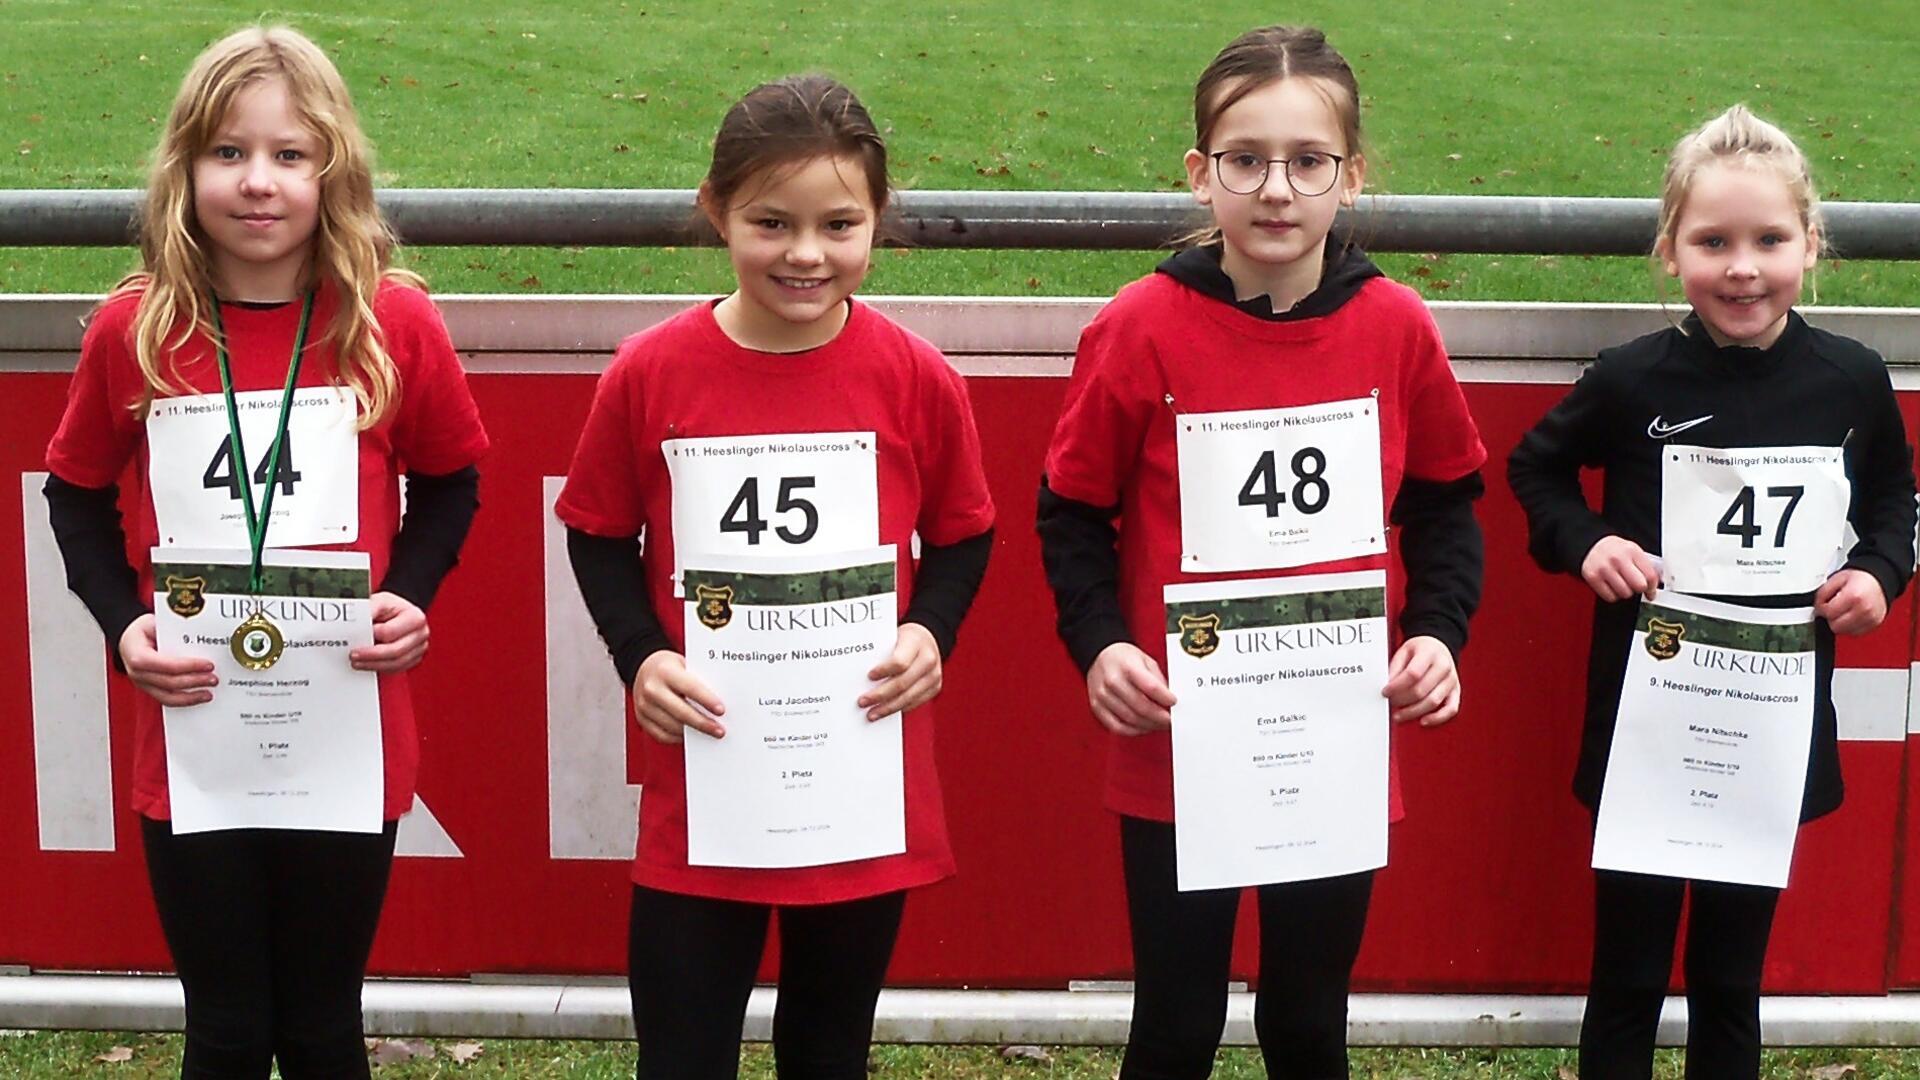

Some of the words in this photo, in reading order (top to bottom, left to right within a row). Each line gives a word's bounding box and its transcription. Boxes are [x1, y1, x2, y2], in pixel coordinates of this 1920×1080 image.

[168, 407, 182, 416] 11.
[185, 402, 245, 416] Heeslinr
[248, 397, 330, 410] Nikolascross
[1201, 423, 1217, 432] 11.
[1221, 418, 1280, 431] Heeslinger
[1283, 410, 1354, 427] Nikolauscross
[684, 447, 700, 457] 11.
[703, 445, 765, 457] Heeslinger
[768, 443, 850, 454] Nikolauscross
[1706, 455, 1760, 467] Heeslinger
[203, 429, 302, 500] 44
[1237, 446, 1331, 519] 48
[719, 475, 819, 546] 45
[1716, 485, 1805, 549] 47
[220, 599, 356, 623] URKUNDE
[747, 600, 883, 631] URKUNDE
[183, 634, 194, 645] 9.
[197, 635, 232, 645] Heesl
[282, 639, 350, 649] olauscross
[1235, 623, 1372, 654] URKUNDE
[708, 650, 719, 660] 9.
[722, 650, 788, 663] Heeslinger
[791, 641, 875, 660] Nikolauscross
[1693, 647, 1808, 676] URKUNDE
[1211, 672, 1275, 687] Heeslinger
[1278, 664, 1364, 680] Nikolauscross
[758, 697, 783, 706] Luna
[785, 695, 831, 706] Jacobsen
[1650, 677, 1660, 687] 9.
[1662, 679, 1723, 697] Heeslinger
[1725, 688, 1799, 703] Nikolauscross
[1689, 724, 1710, 734] Mara
